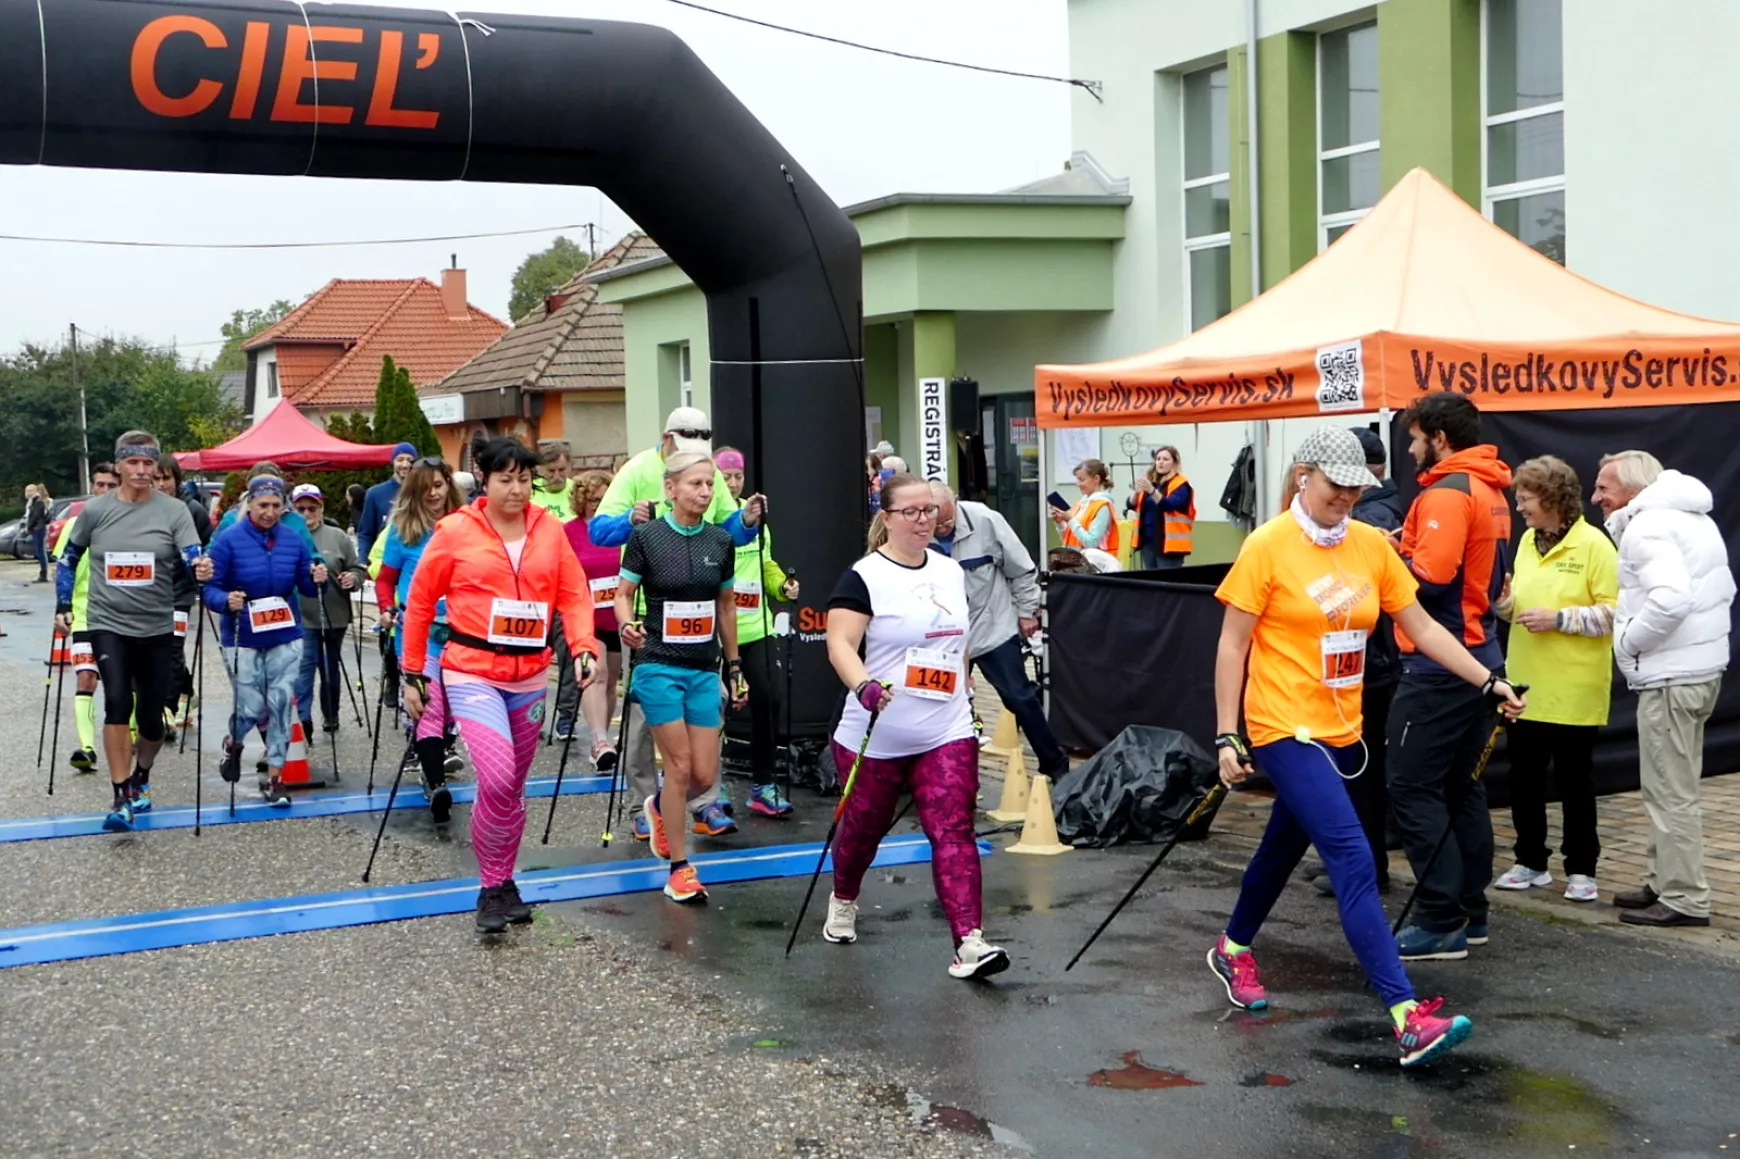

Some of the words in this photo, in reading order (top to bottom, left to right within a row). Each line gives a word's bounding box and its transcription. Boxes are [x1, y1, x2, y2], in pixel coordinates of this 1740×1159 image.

[1410, 347, 1740, 399] VysledkovyServis.
[1049, 367, 1295, 420] VysledkovyServis.sk
[114, 565, 145, 579] 279
[600, 587, 618, 600] 25
[734, 593, 757, 608] 292
[260, 608, 286, 624] 129
[799, 606, 828, 631] Su
[502, 617, 538, 635] 107
[680, 619, 703, 635] 96
[800, 633, 828, 643] Vysled
[917, 667, 951, 690] 142
